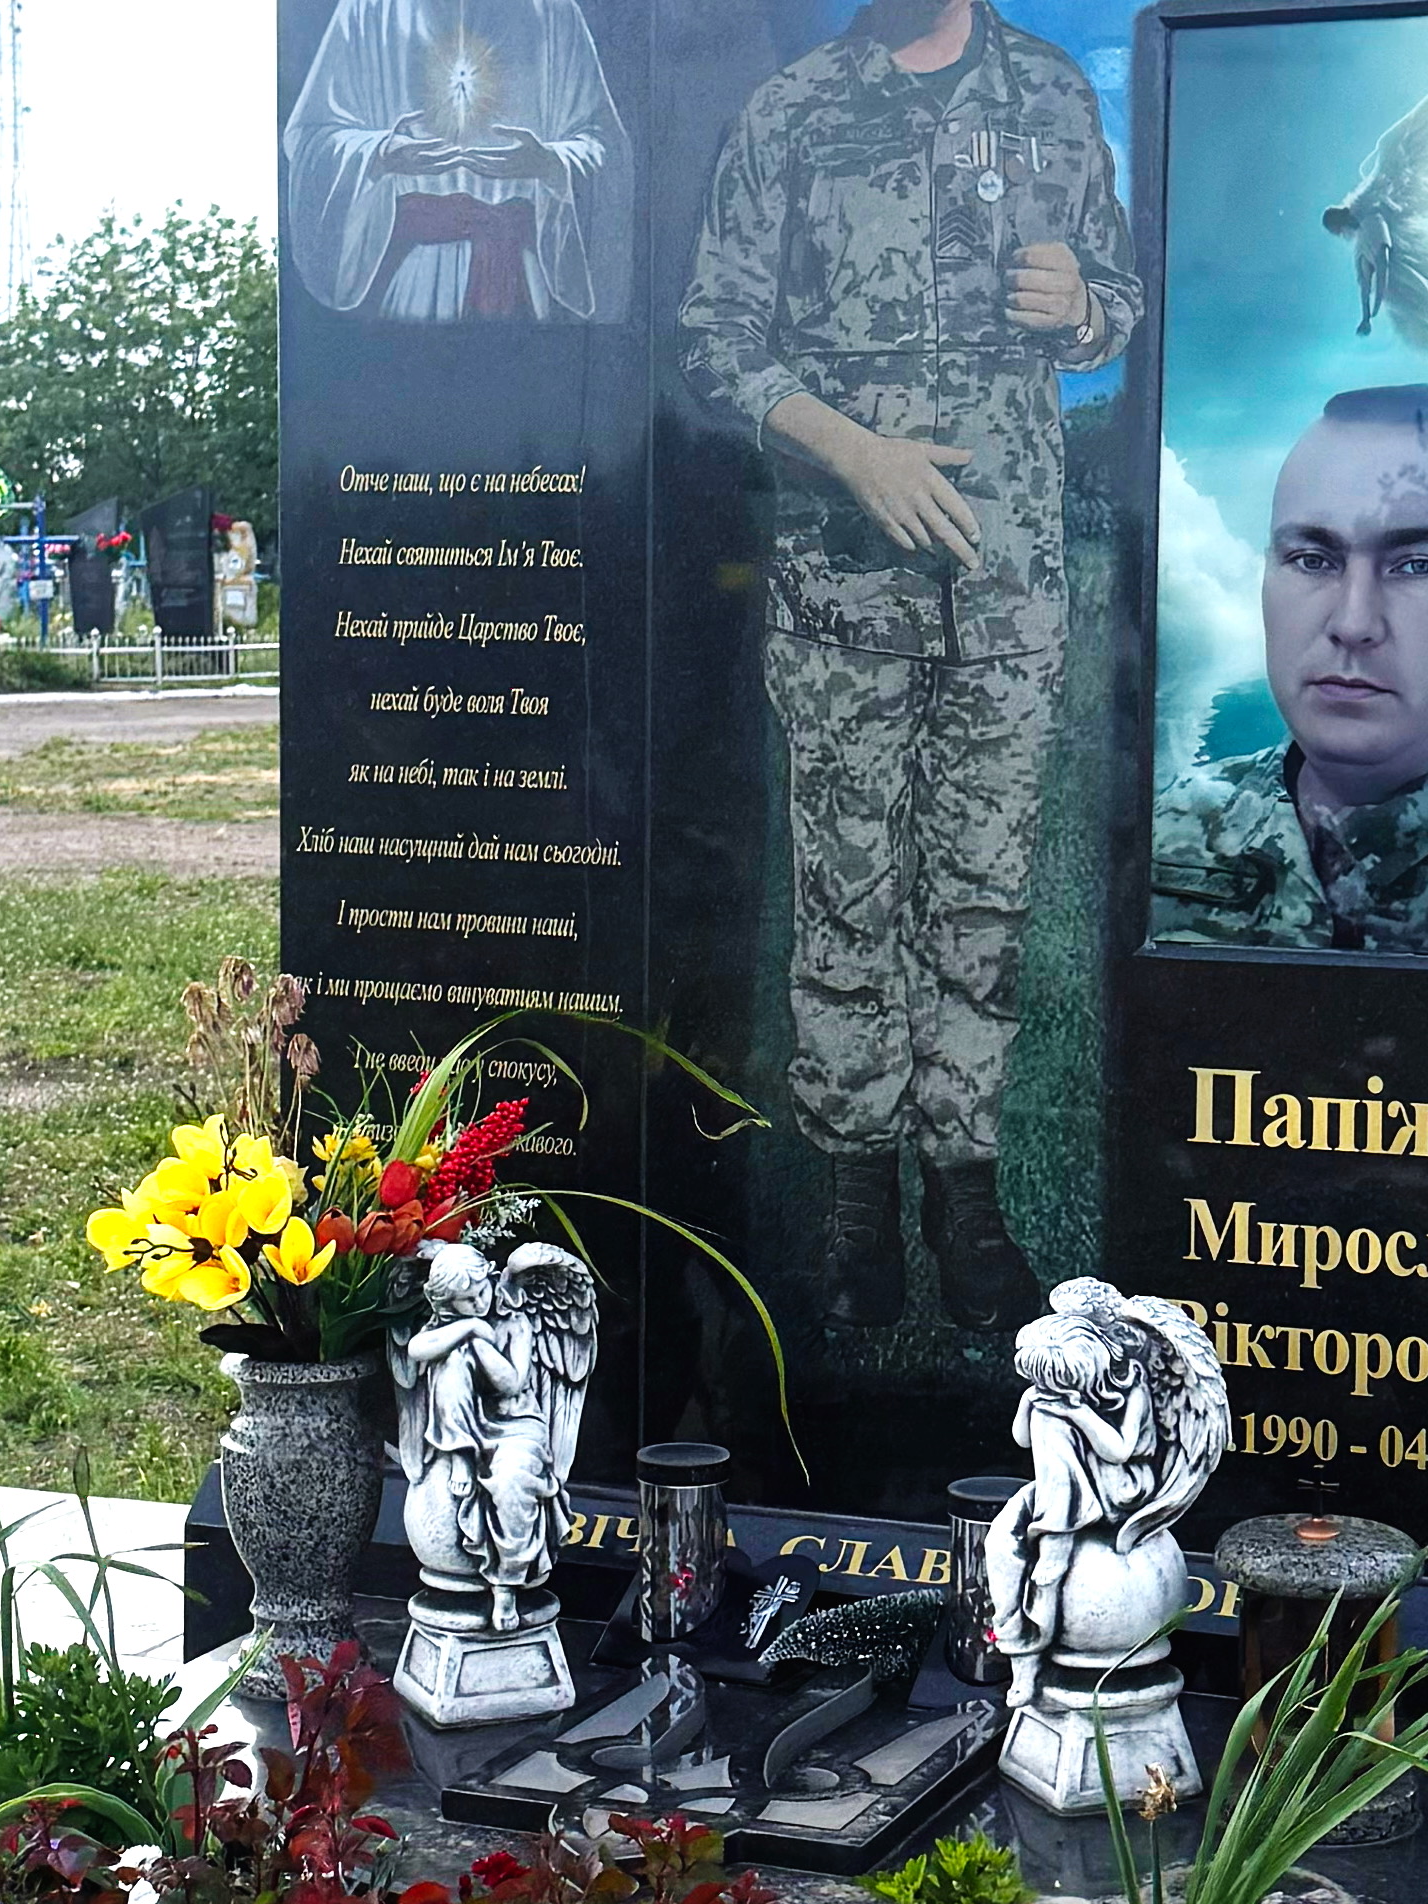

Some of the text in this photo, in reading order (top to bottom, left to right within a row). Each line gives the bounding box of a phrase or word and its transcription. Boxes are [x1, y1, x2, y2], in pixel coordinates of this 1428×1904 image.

[340, 464, 587, 499] Отче наш, що є на небесах!
[338, 538, 393, 566] Нехай
[396, 546, 493, 567] святиться
[540, 540, 584, 568] Твоє.
[335, 610, 586, 649] Нехай прийде Царство Твоє,
[370, 685, 549, 719] нехай буде воля Твоя
[348, 757, 568, 791] як на небі, так і на землі.
[296, 825, 623, 866] Хліб наш насущний дай нам сьогодні.
[337, 899, 579, 941] І прости нам провини наші,
[316, 971, 324, 995] і
[324, 977, 351, 997] ми
[353, 980, 443, 1005] прощаємо
[557, 991, 624, 1013] нашим.
[365, 1052, 385, 1069] не
[488, 1059, 557, 1087] спокусу,
[780, 1536, 951, 1585] СЛАВ
